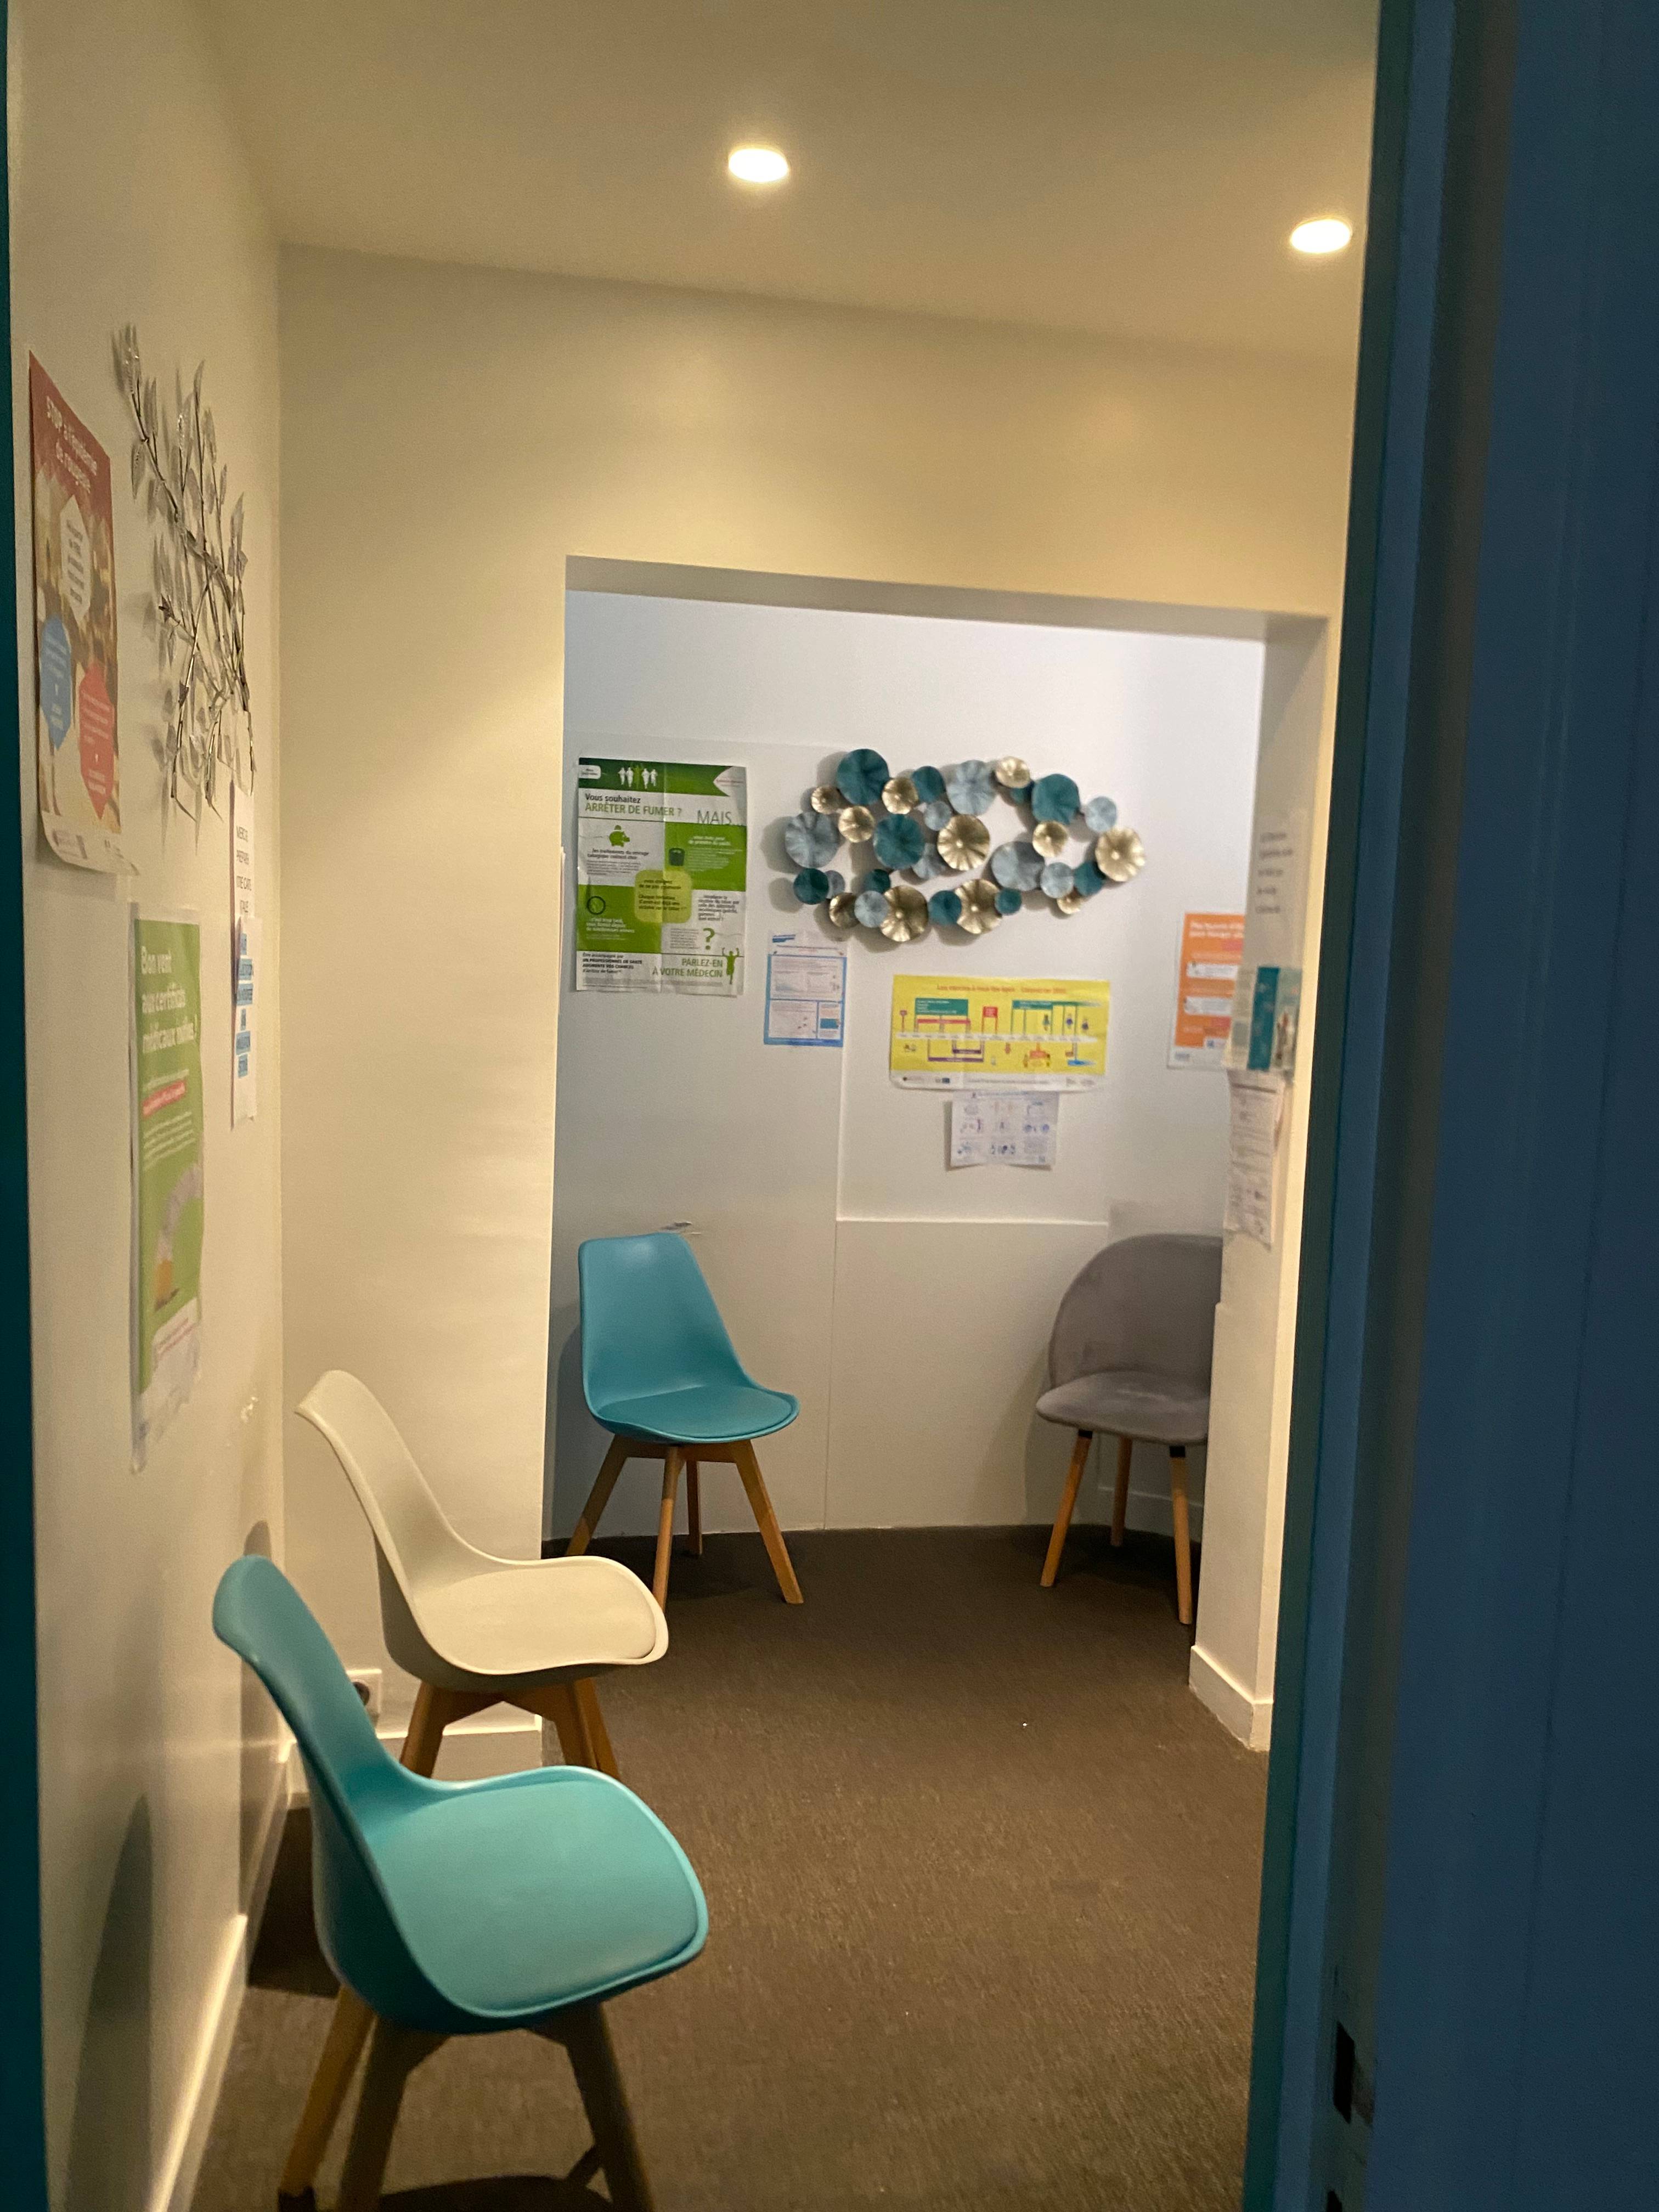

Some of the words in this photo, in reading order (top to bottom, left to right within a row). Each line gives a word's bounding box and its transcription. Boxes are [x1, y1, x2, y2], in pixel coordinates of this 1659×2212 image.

[585, 793, 603, 802] Vous
[605, 795, 641, 804] souhaitez
[585, 802, 625, 814] ARRÊTER
[628, 805, 641, 815] DE
[643, 806, 674, 816] FUMER
[678, 808, 682, 817] ?
[682, 958, 723, 968] PARLEZ-EN
[660, 968, 685, 977] VOTRE
